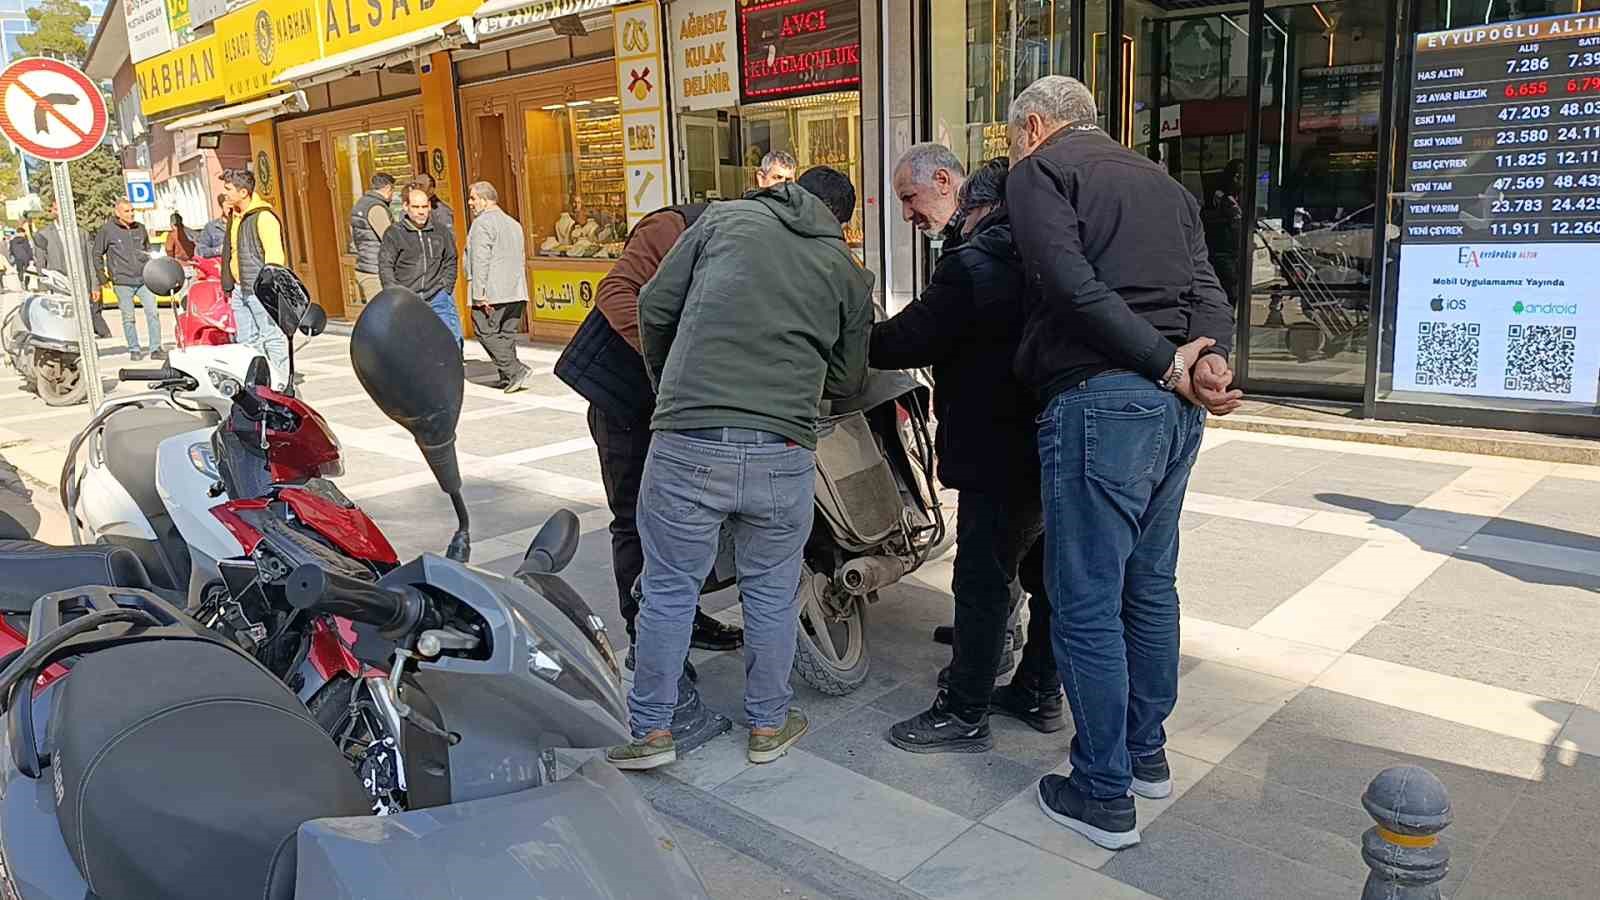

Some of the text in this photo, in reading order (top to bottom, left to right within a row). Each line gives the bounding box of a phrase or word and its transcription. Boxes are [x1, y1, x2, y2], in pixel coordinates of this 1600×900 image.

[276, 8, 312, 43] NABHAN
[680, 10, 727, 40] AĞRISIZ
[780, 11, 827, 37] AVCI
[1549, 17, 1600, 34] ALTI
[685, 41, 726, 68] KULAK
[1519, 44, 1539, 54] ALIŞ
[137, 47, 215, 100] NABHAN
[1418, 71, 1436, 80] HAS
[1438, 68, 1464, 78] ALTIN
[1507, 57, 1549, 73] 7.286
[683, 69, 731, 97] DELİNİR
[1416, 95, 1426, 103] 22
[1429, 92, 1452, 102] AYAR
[1453, 88, 1487, 99] BİLEZİK
[1505, 81, 1548, 97] 6.655
[1415, 115, 1434, 125] ESKİ
[1436, 114, 1455, 123] TAM
[1498, 106, 1550, 120] 47.203
[1414, 137, 1433, 147] ESKİ
[1435, 136, 1462, 145] YARIM
[1497, 129, 1548, 144] 23.580
[1413, 150, 1599, 170] ESKİ ÇEYREK 11.825 12.11
[131, 183, 149, 202] D
[1411, 182, 1430, 191] YENİ
[1433, 182, 1452, 190] TAM
[1493, 176, 1544, 190] 47.569
[1410, 204, 1429, 213] YENİ
[1431, 203, 1459, 213] YARIM
[1492, 199, 1542, 212] 23.783
[1408, 226, 1427, 235] YENİ
[1429, 226, 1463, 237] ÇEYREK
[1491, 222, 1539, 235] 11.911
[1433, 278, 1565, 288] Mobil Uygulamamız Yayında
[536, 283, 575, 309] النبهان
[1447, 299, 1577, 315] iOS android
